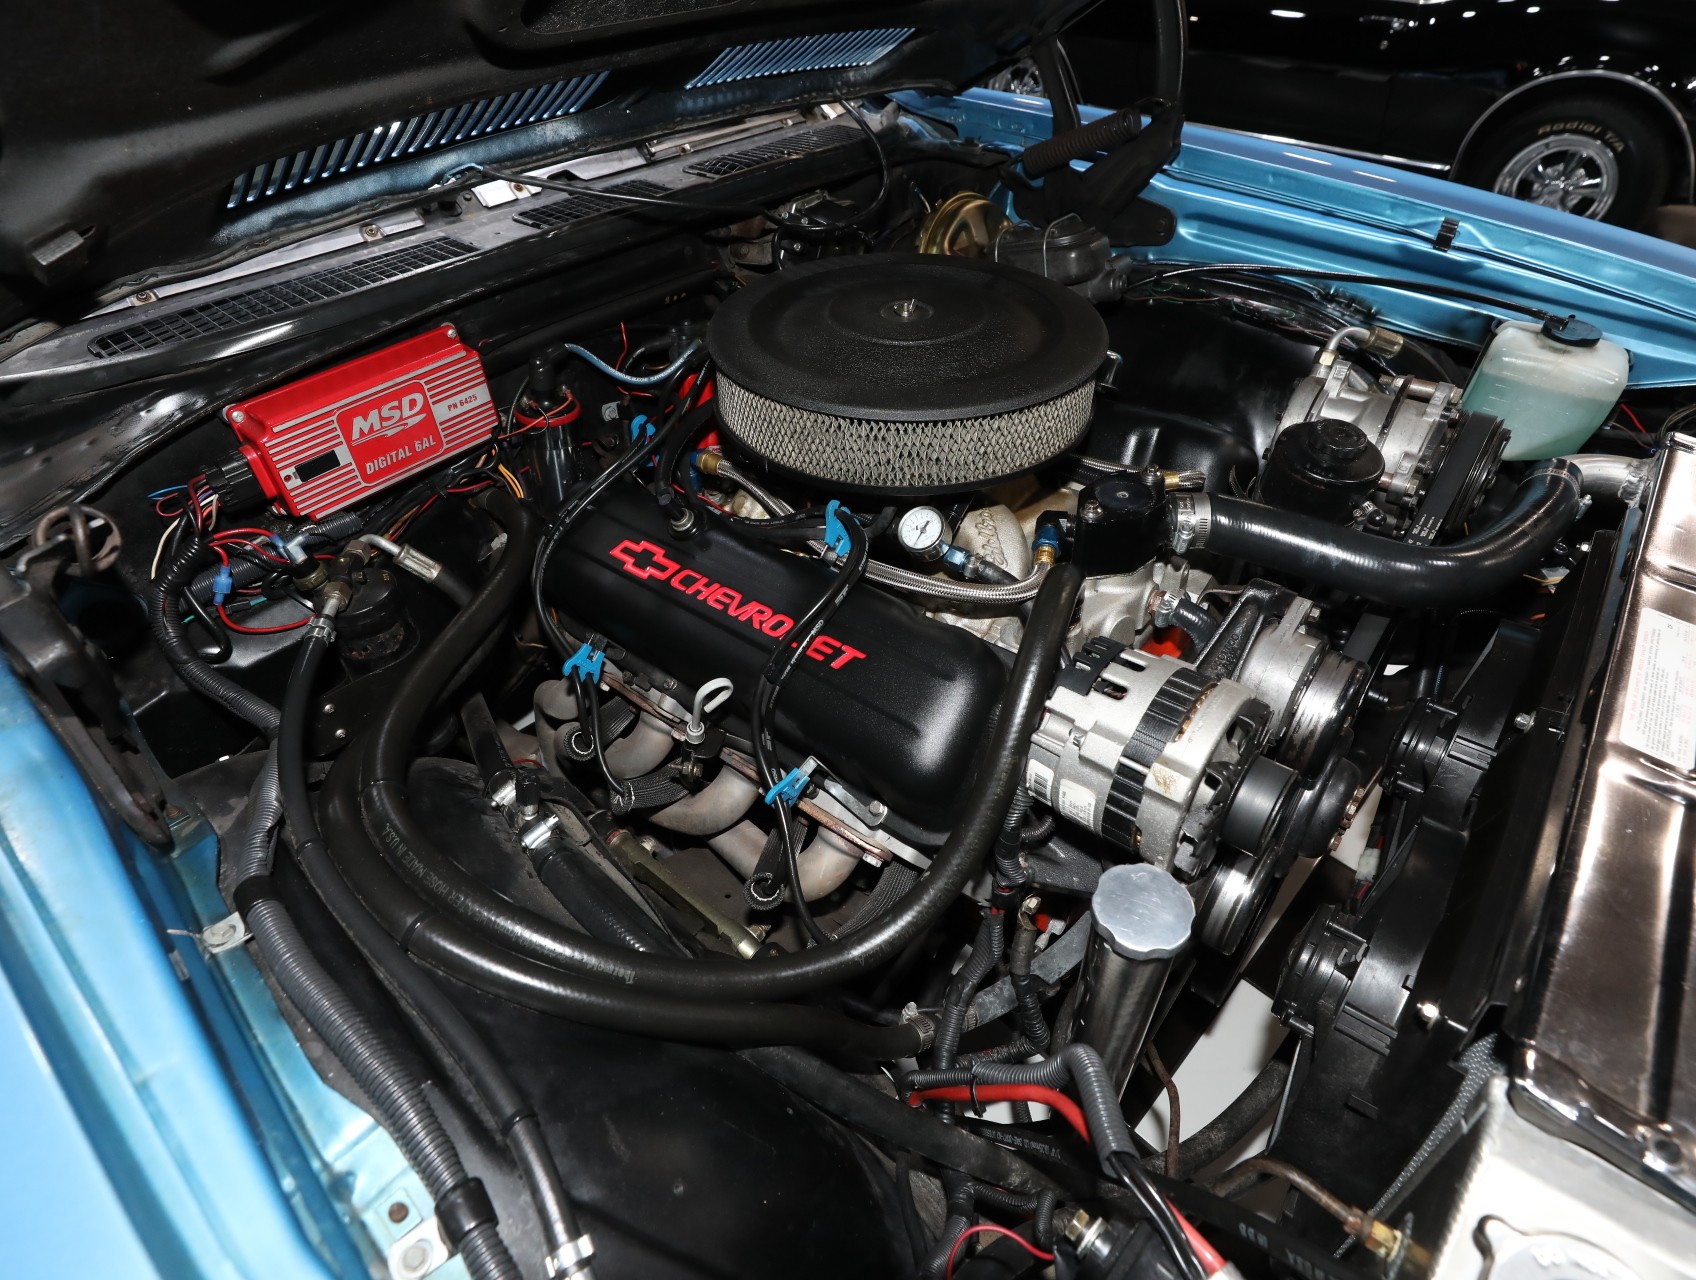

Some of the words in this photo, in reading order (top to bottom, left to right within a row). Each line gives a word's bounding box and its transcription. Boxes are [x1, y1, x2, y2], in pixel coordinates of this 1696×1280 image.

[351, 392, 425, 441] MSD
[447, 403, 459, 412] PN
[460, 395, 478, 407] 6425
[366, 446, 413, 475] DIGITAL
[415, 435, 437, 453] 6AL
[975, 508, 1009, 569] Edelbro
[393, 842, 407, 857] IN
[400, 850, 428, 879] MADE
[422, 870, 449, 897] HOSE
